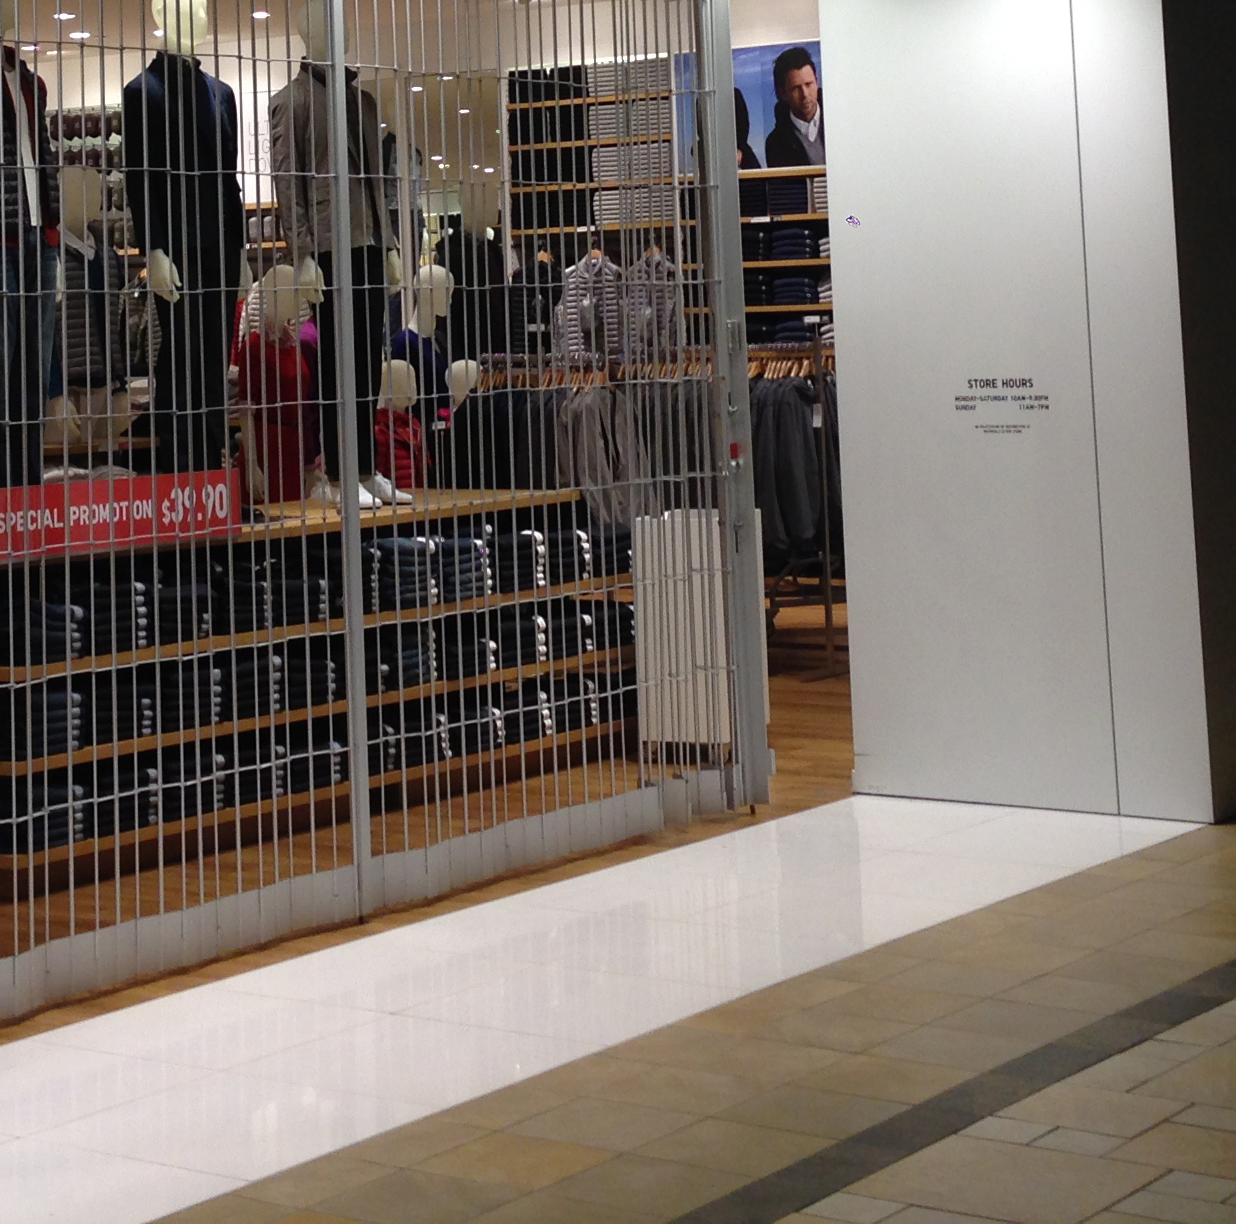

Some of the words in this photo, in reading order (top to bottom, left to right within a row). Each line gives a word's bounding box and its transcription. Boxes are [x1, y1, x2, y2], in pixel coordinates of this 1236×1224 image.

[967, 378, 998, 389] STORE
[1002, 378, 1034, 389] HOURS
[69, 499, 153, 527] PROMOTON
[162, 483, 228, 527] $39.90
